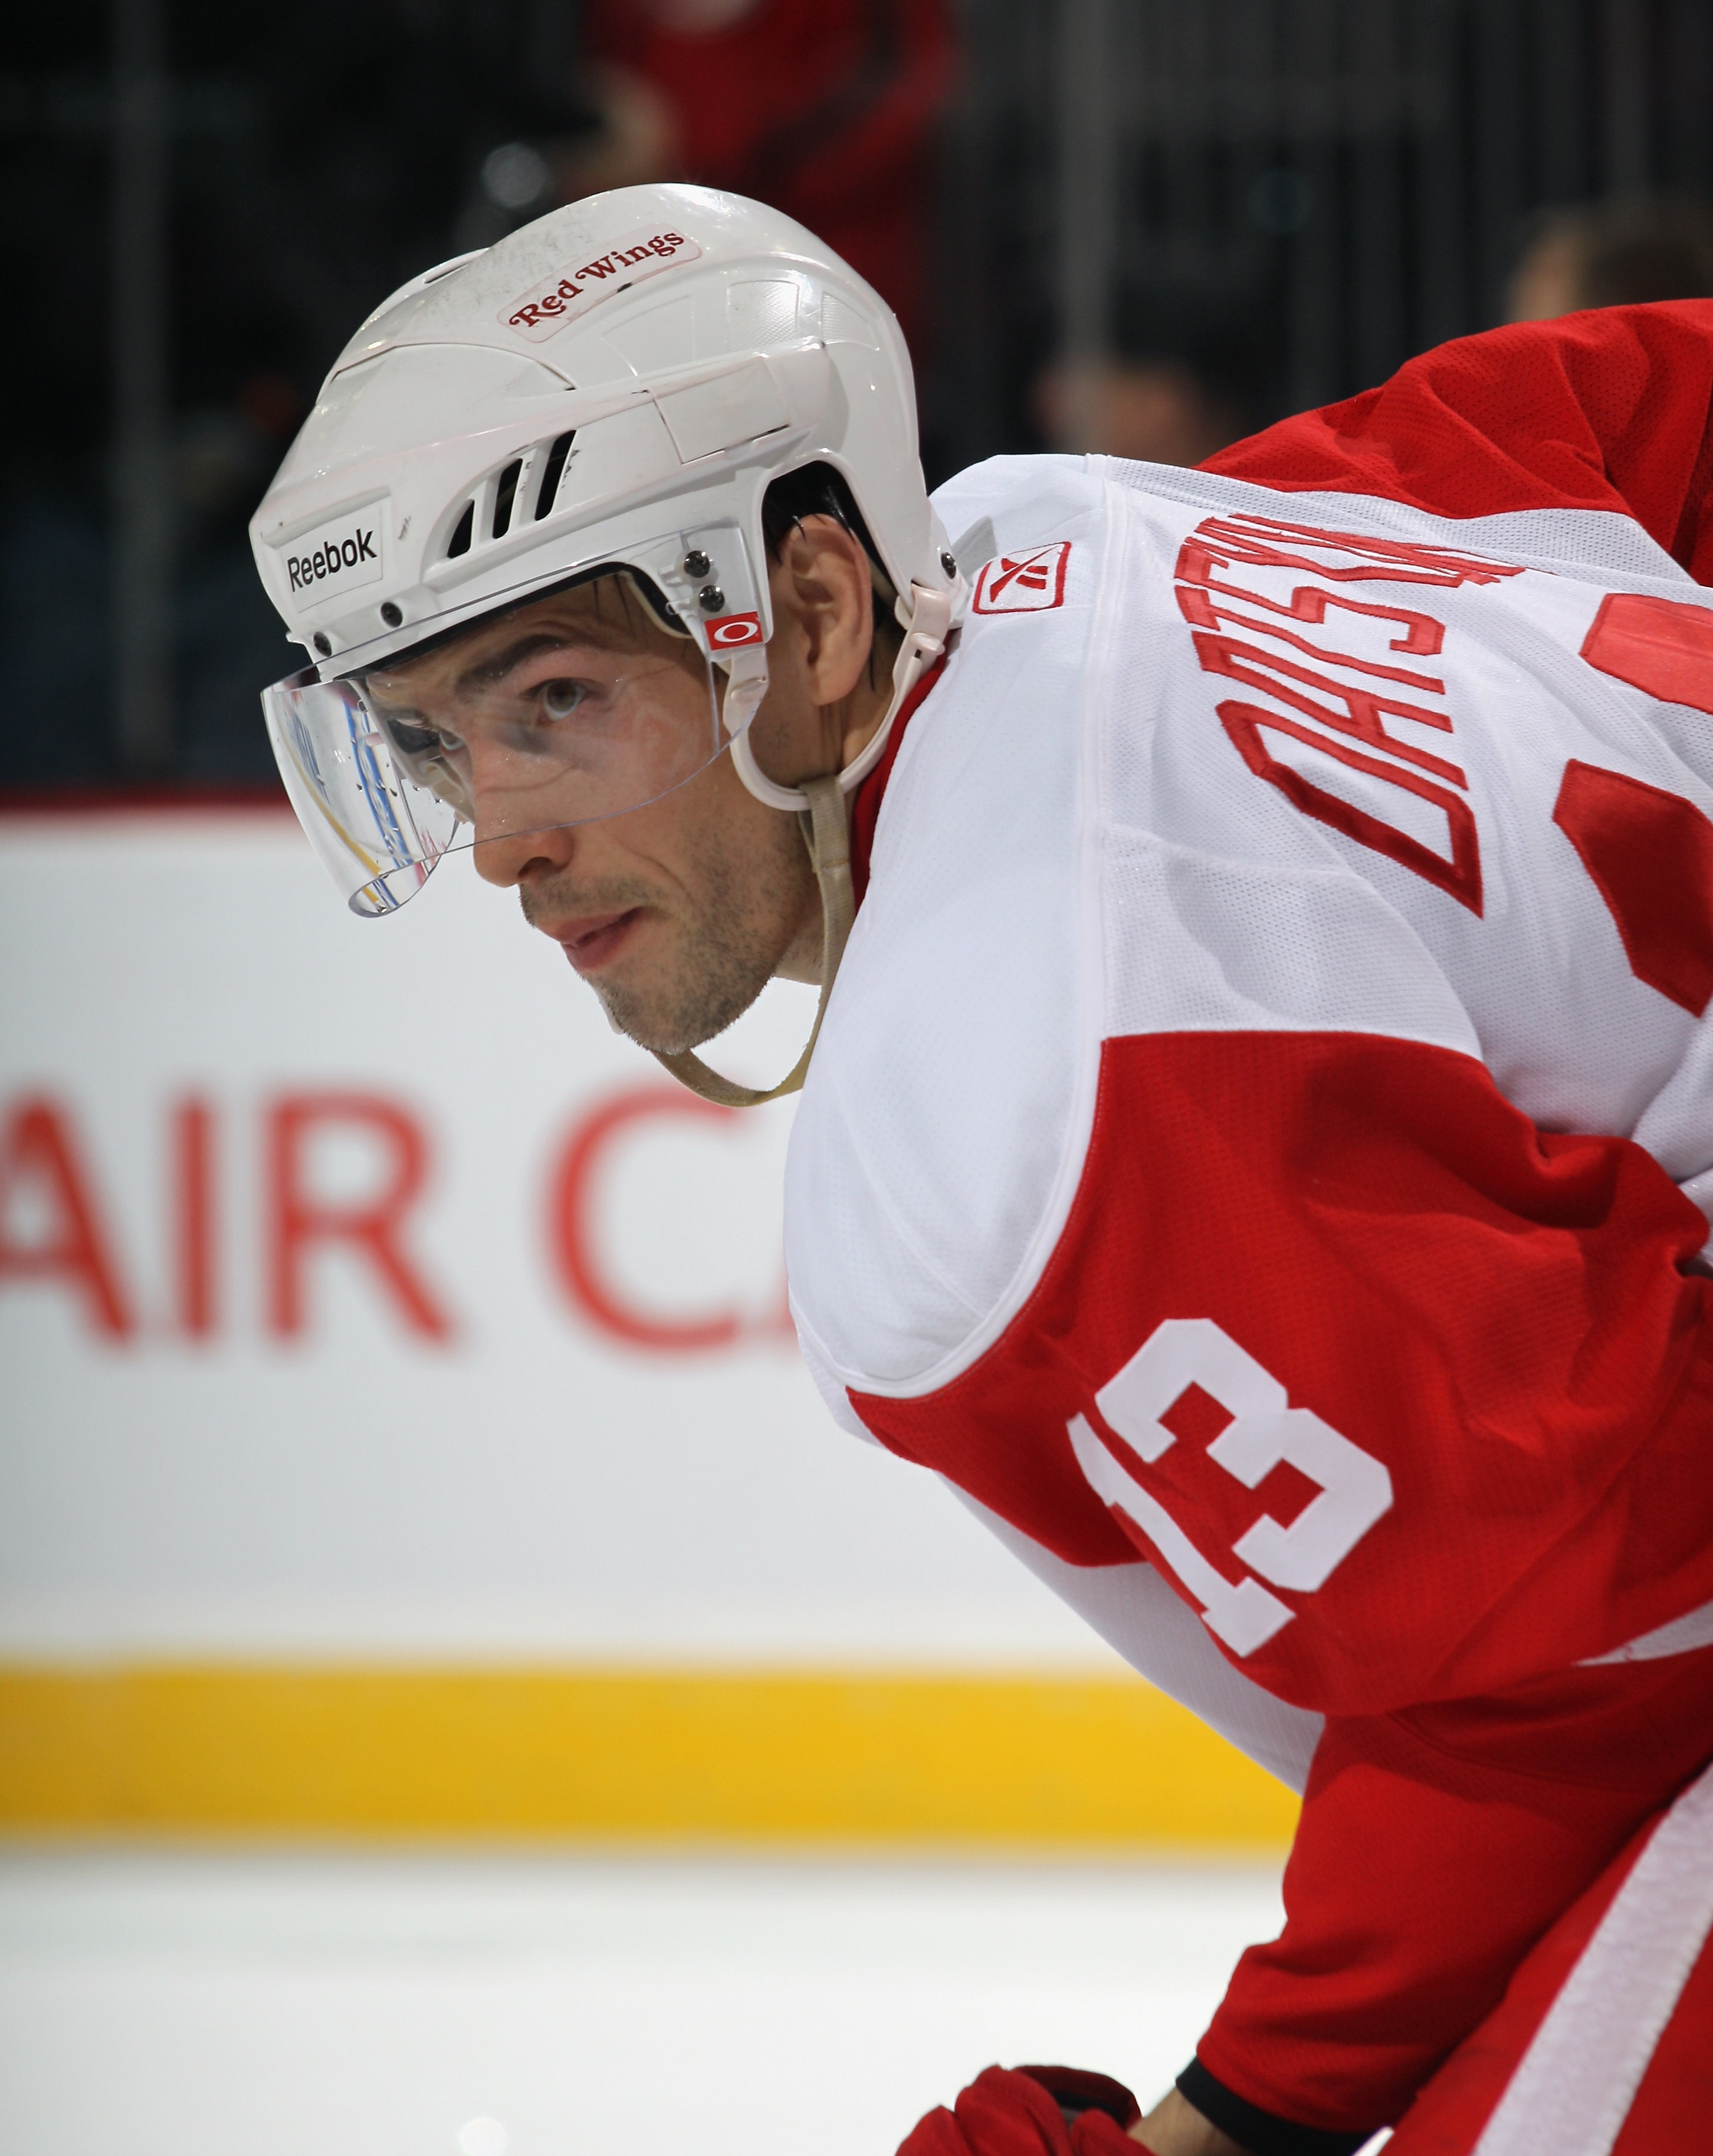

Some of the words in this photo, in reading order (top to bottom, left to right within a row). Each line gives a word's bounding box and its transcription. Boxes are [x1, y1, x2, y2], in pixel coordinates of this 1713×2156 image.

[509, 279, 584, 327] Red
[575, 232, 684, 280] Wings
[287, 528, 378, 593] Reebok
[0, 1082, 454, 1352] AIR
[540, 1076, 796, 1362] C
[1066, 1317, 1394, 1658] 13
